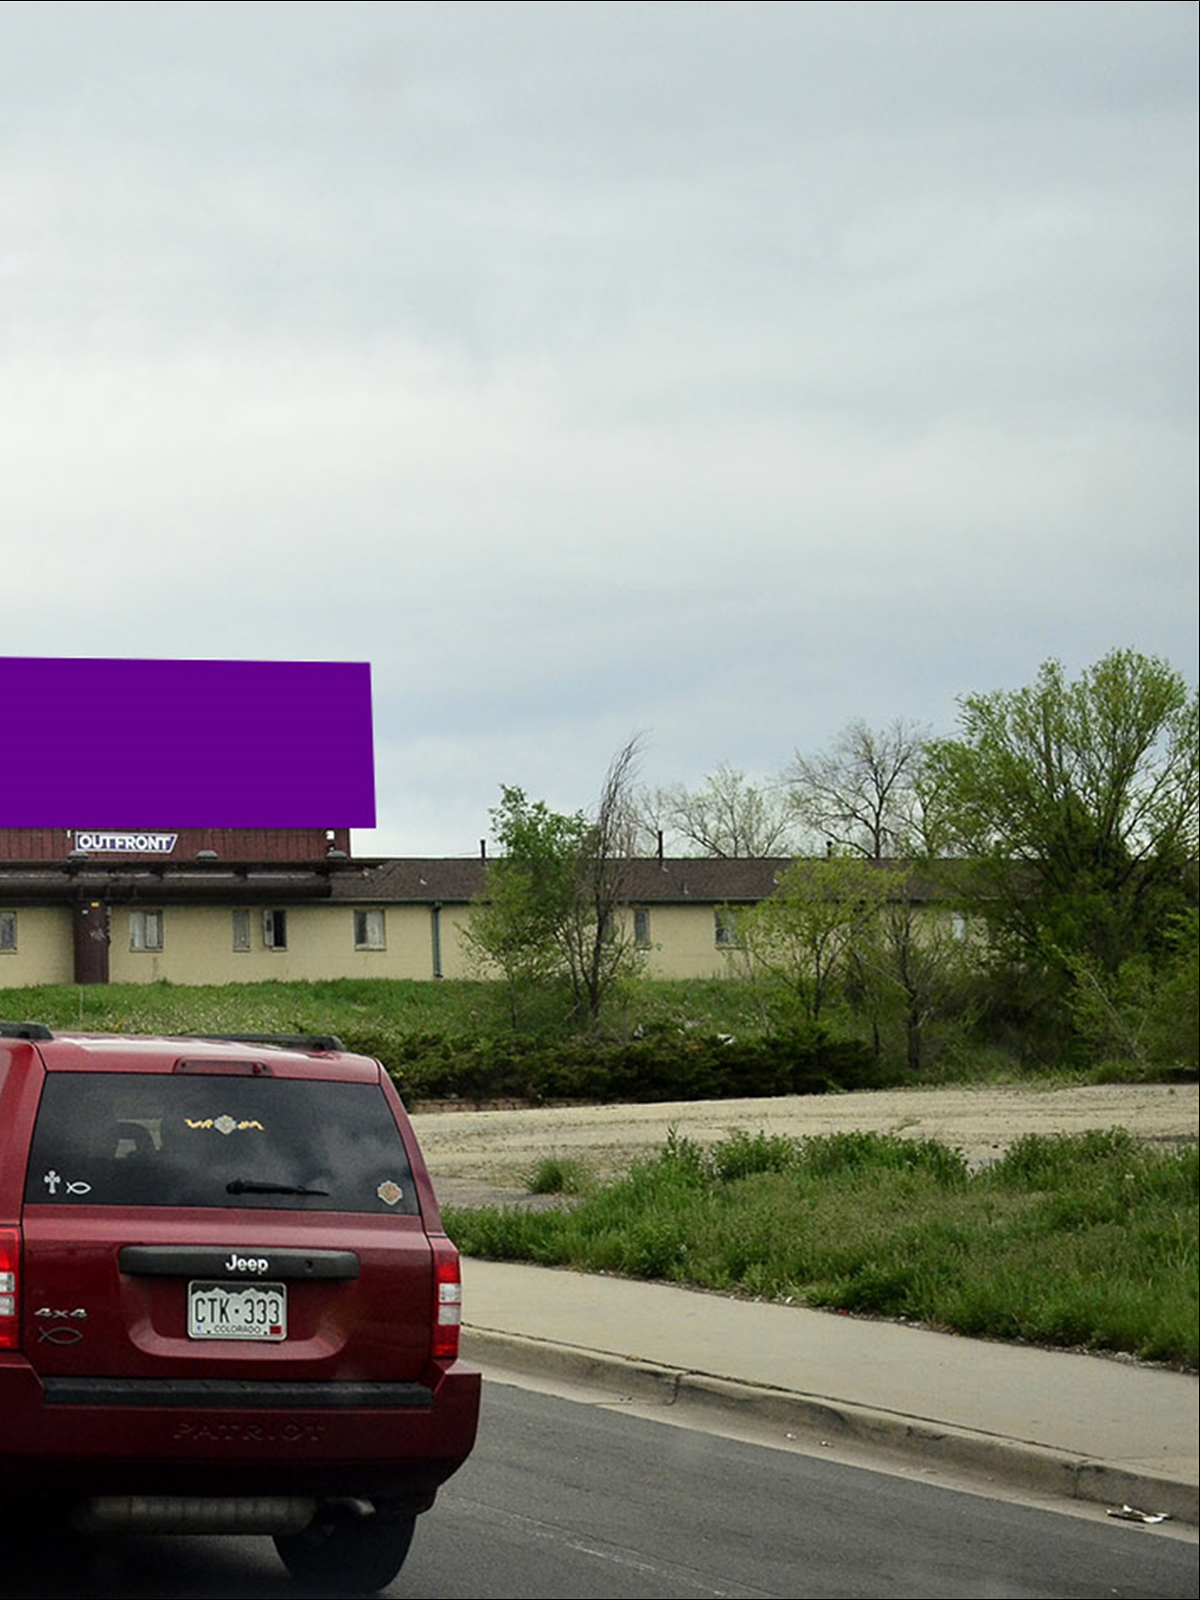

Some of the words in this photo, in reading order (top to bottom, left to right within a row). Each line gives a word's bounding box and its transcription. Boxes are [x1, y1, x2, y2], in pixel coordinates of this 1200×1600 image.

[79, 835, 171, 851] OUTFRONT
[225, 1254, 269, 1275] Jeep
[214, 1325, 261, 1334] COLORADO
[173, 1422, 326, 1441] PATRIOT
